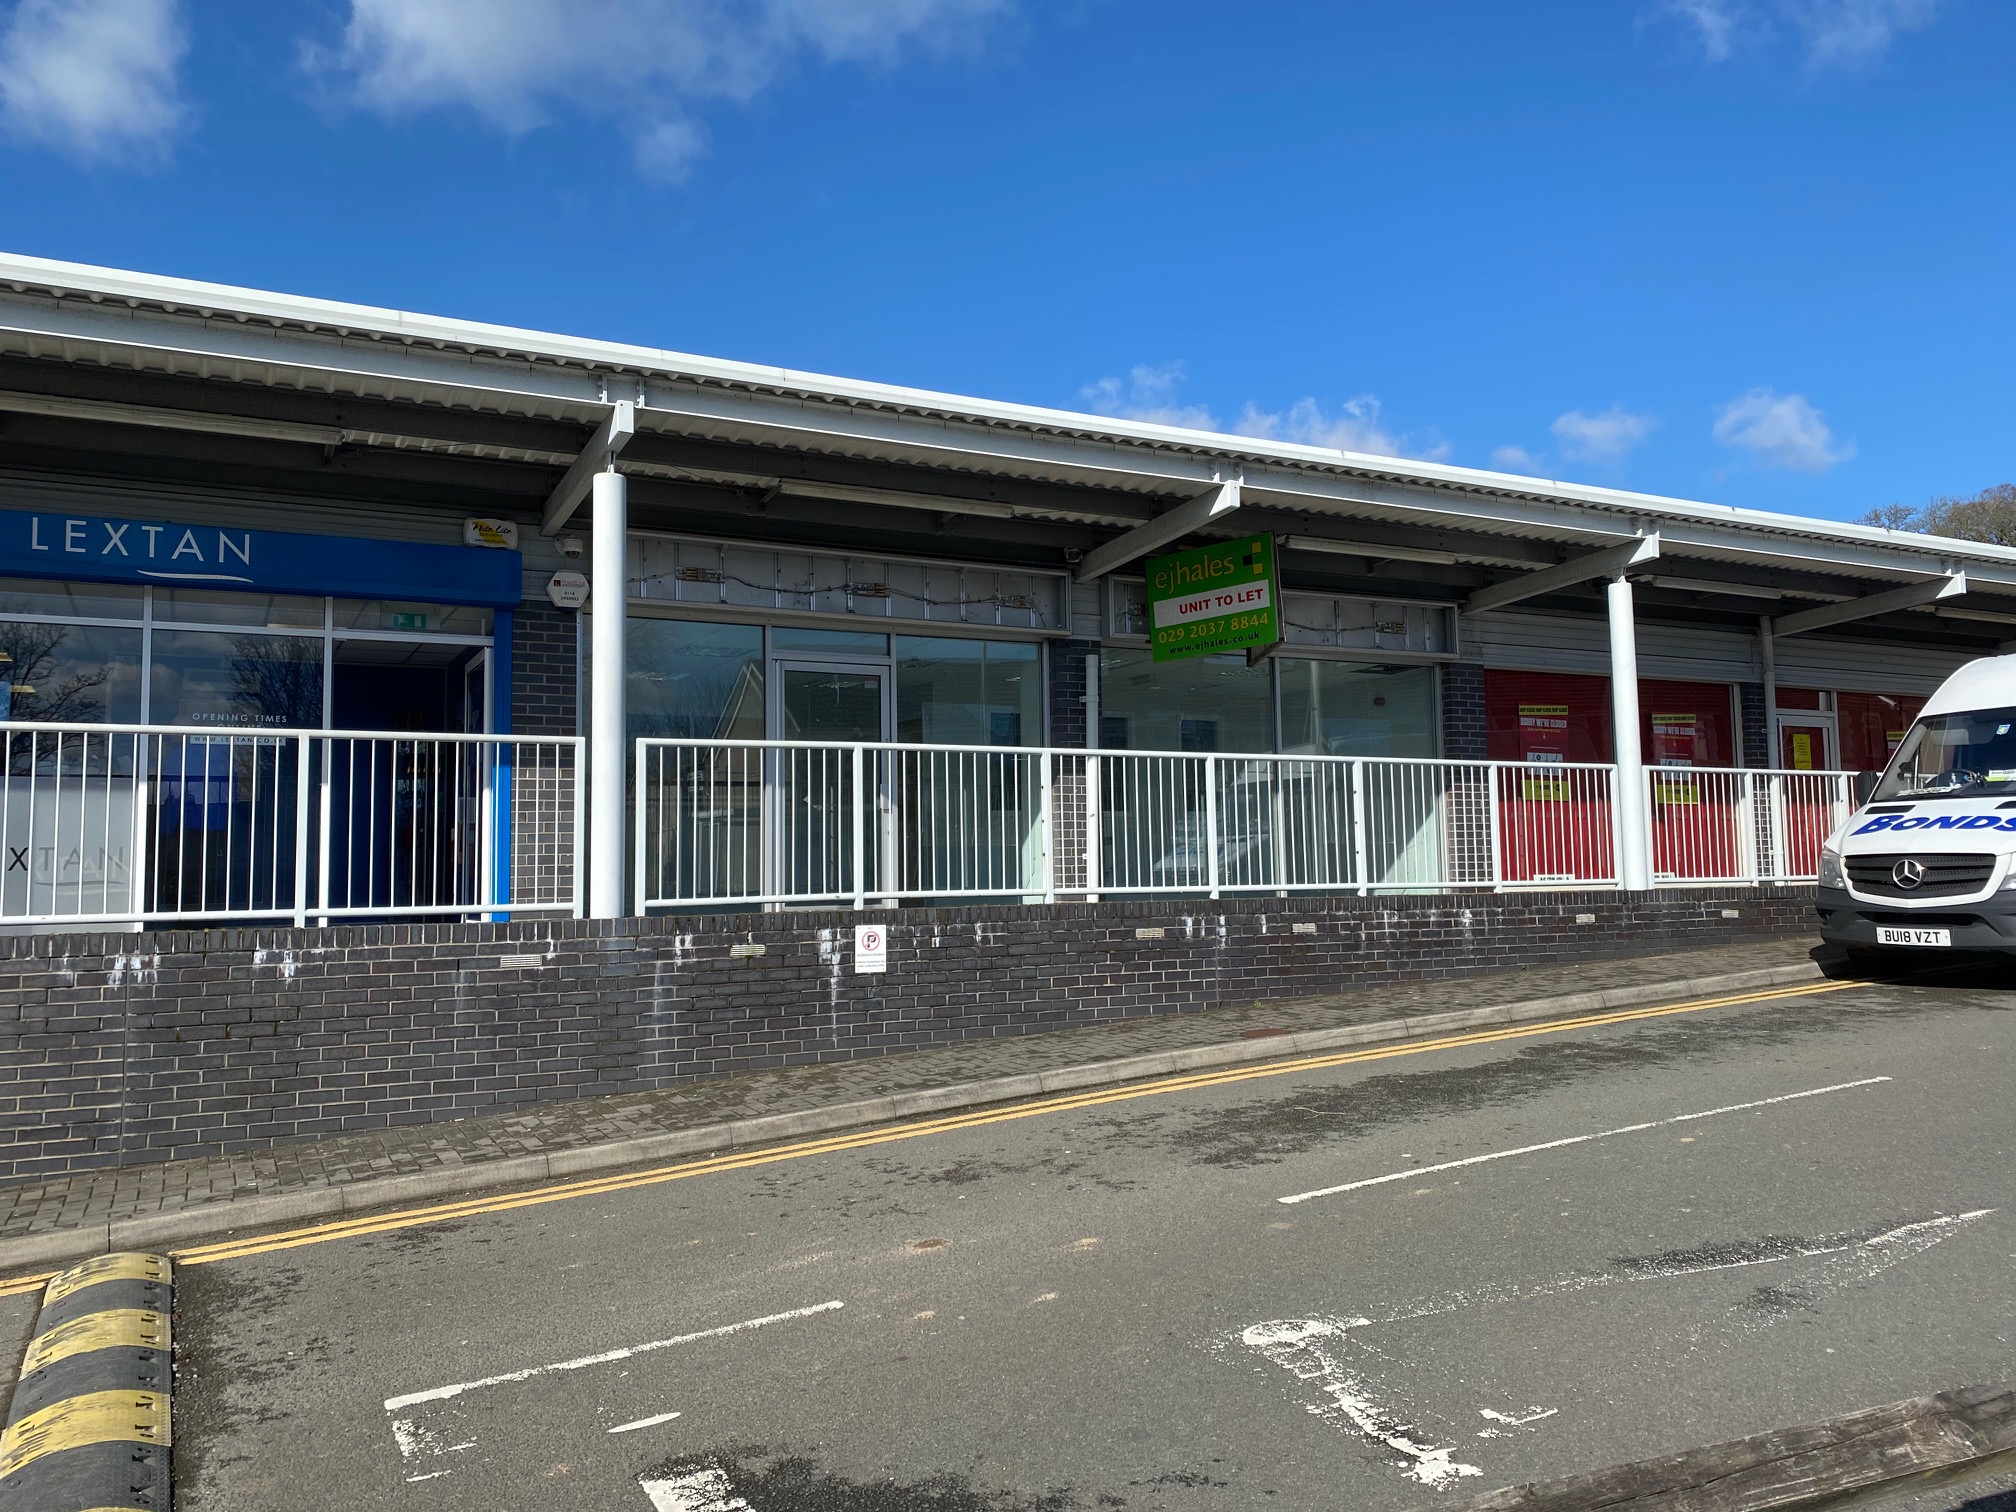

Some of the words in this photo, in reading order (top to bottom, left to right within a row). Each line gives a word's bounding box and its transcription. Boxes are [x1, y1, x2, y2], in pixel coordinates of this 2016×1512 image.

[31, 516, 250, 566] LEXTAN
[1155, 554, 1235, 594] ejhales
[1179, 599, 1211, 615] UNIT
[1215, 594, 1233, 607] TO
[1237, 588, 1264, 603] LET
[1158, 628, 1185, 644] 029
[1189, 620, 1225, 638] 2037
[1230, 612, 1269, 631] 8844
[1168, 631, 1260, 655] www.ejhales.co.uk
[192, 713, 249, 722] OPENING
[255, 714, 287, 723] TIMES
[1884, 930, 1911, 942] BU18
[1914, 931, 1941, 943] VZT
